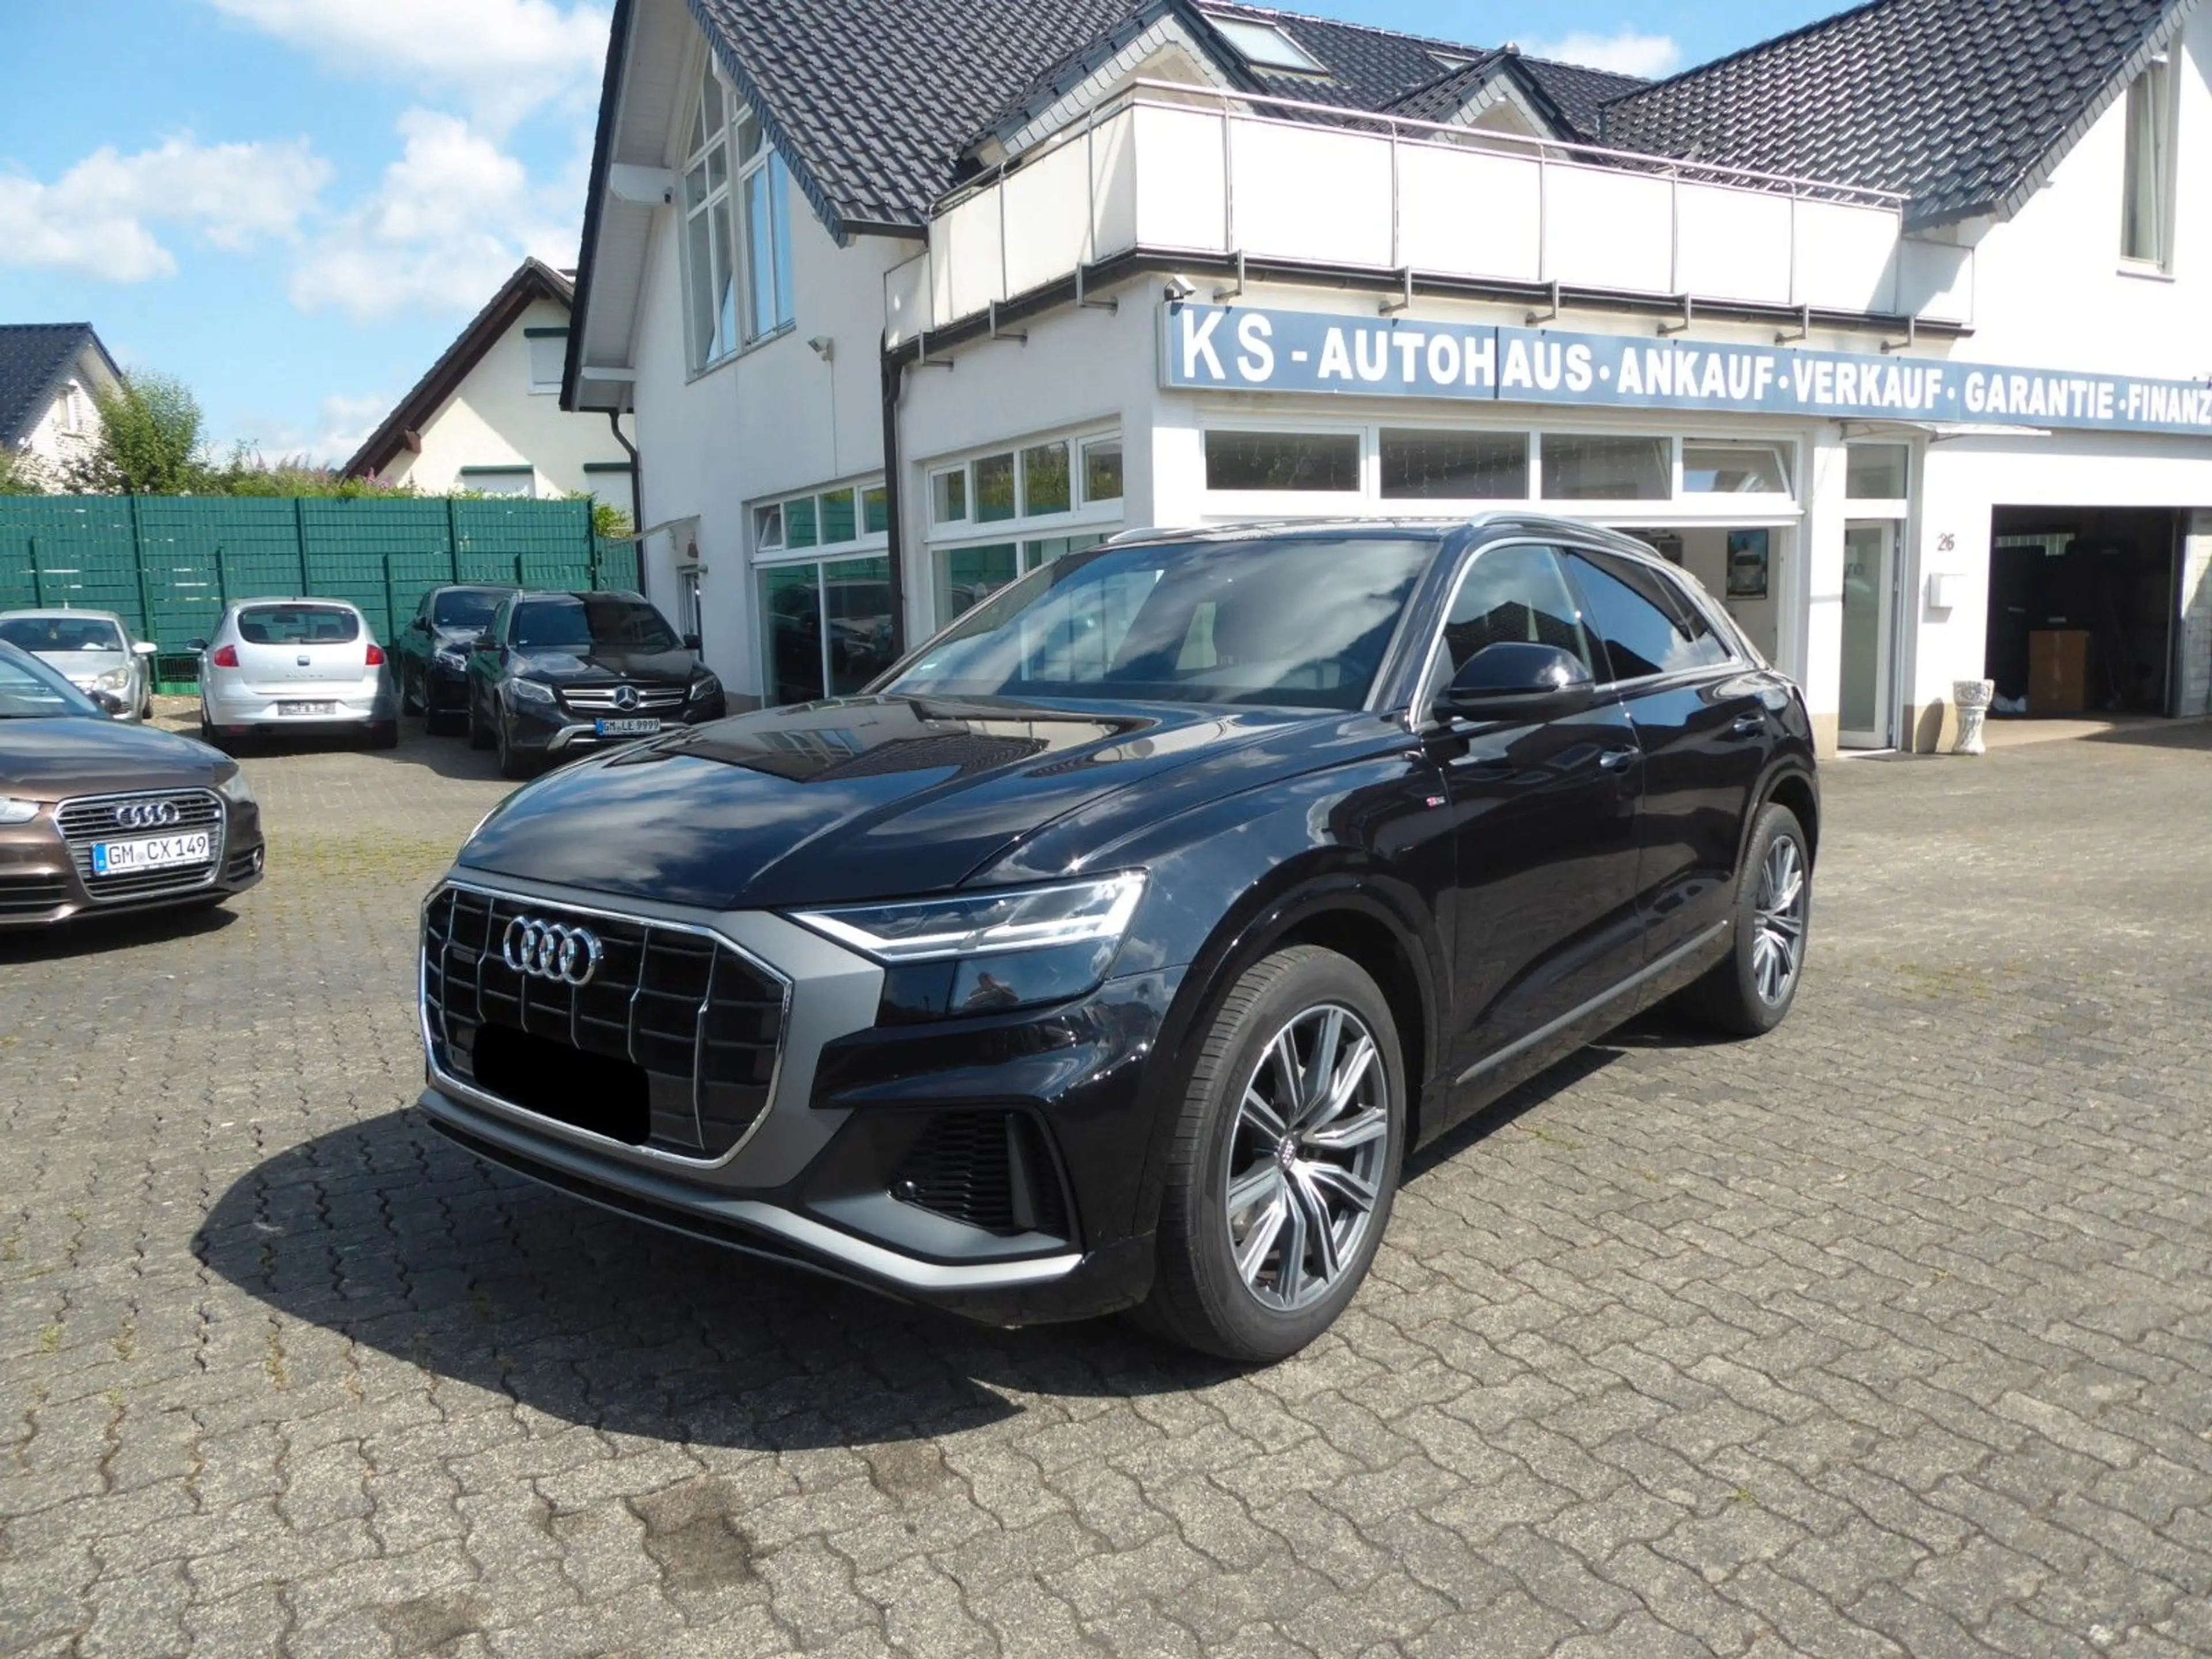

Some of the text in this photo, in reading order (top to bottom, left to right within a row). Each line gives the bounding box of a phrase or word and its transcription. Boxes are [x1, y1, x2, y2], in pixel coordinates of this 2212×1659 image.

[1317, 327, 1593, 392] AUTOHAUS
[1616, 346, 1775, 401] ANKAUF
[1792, 358, 1944, 410] VERKAUF
[1964, 371, 2115, 420] GARANTIE
[1937, 532, 1955, 552] 26
[108, 836, 206, 865] GM CX 149
